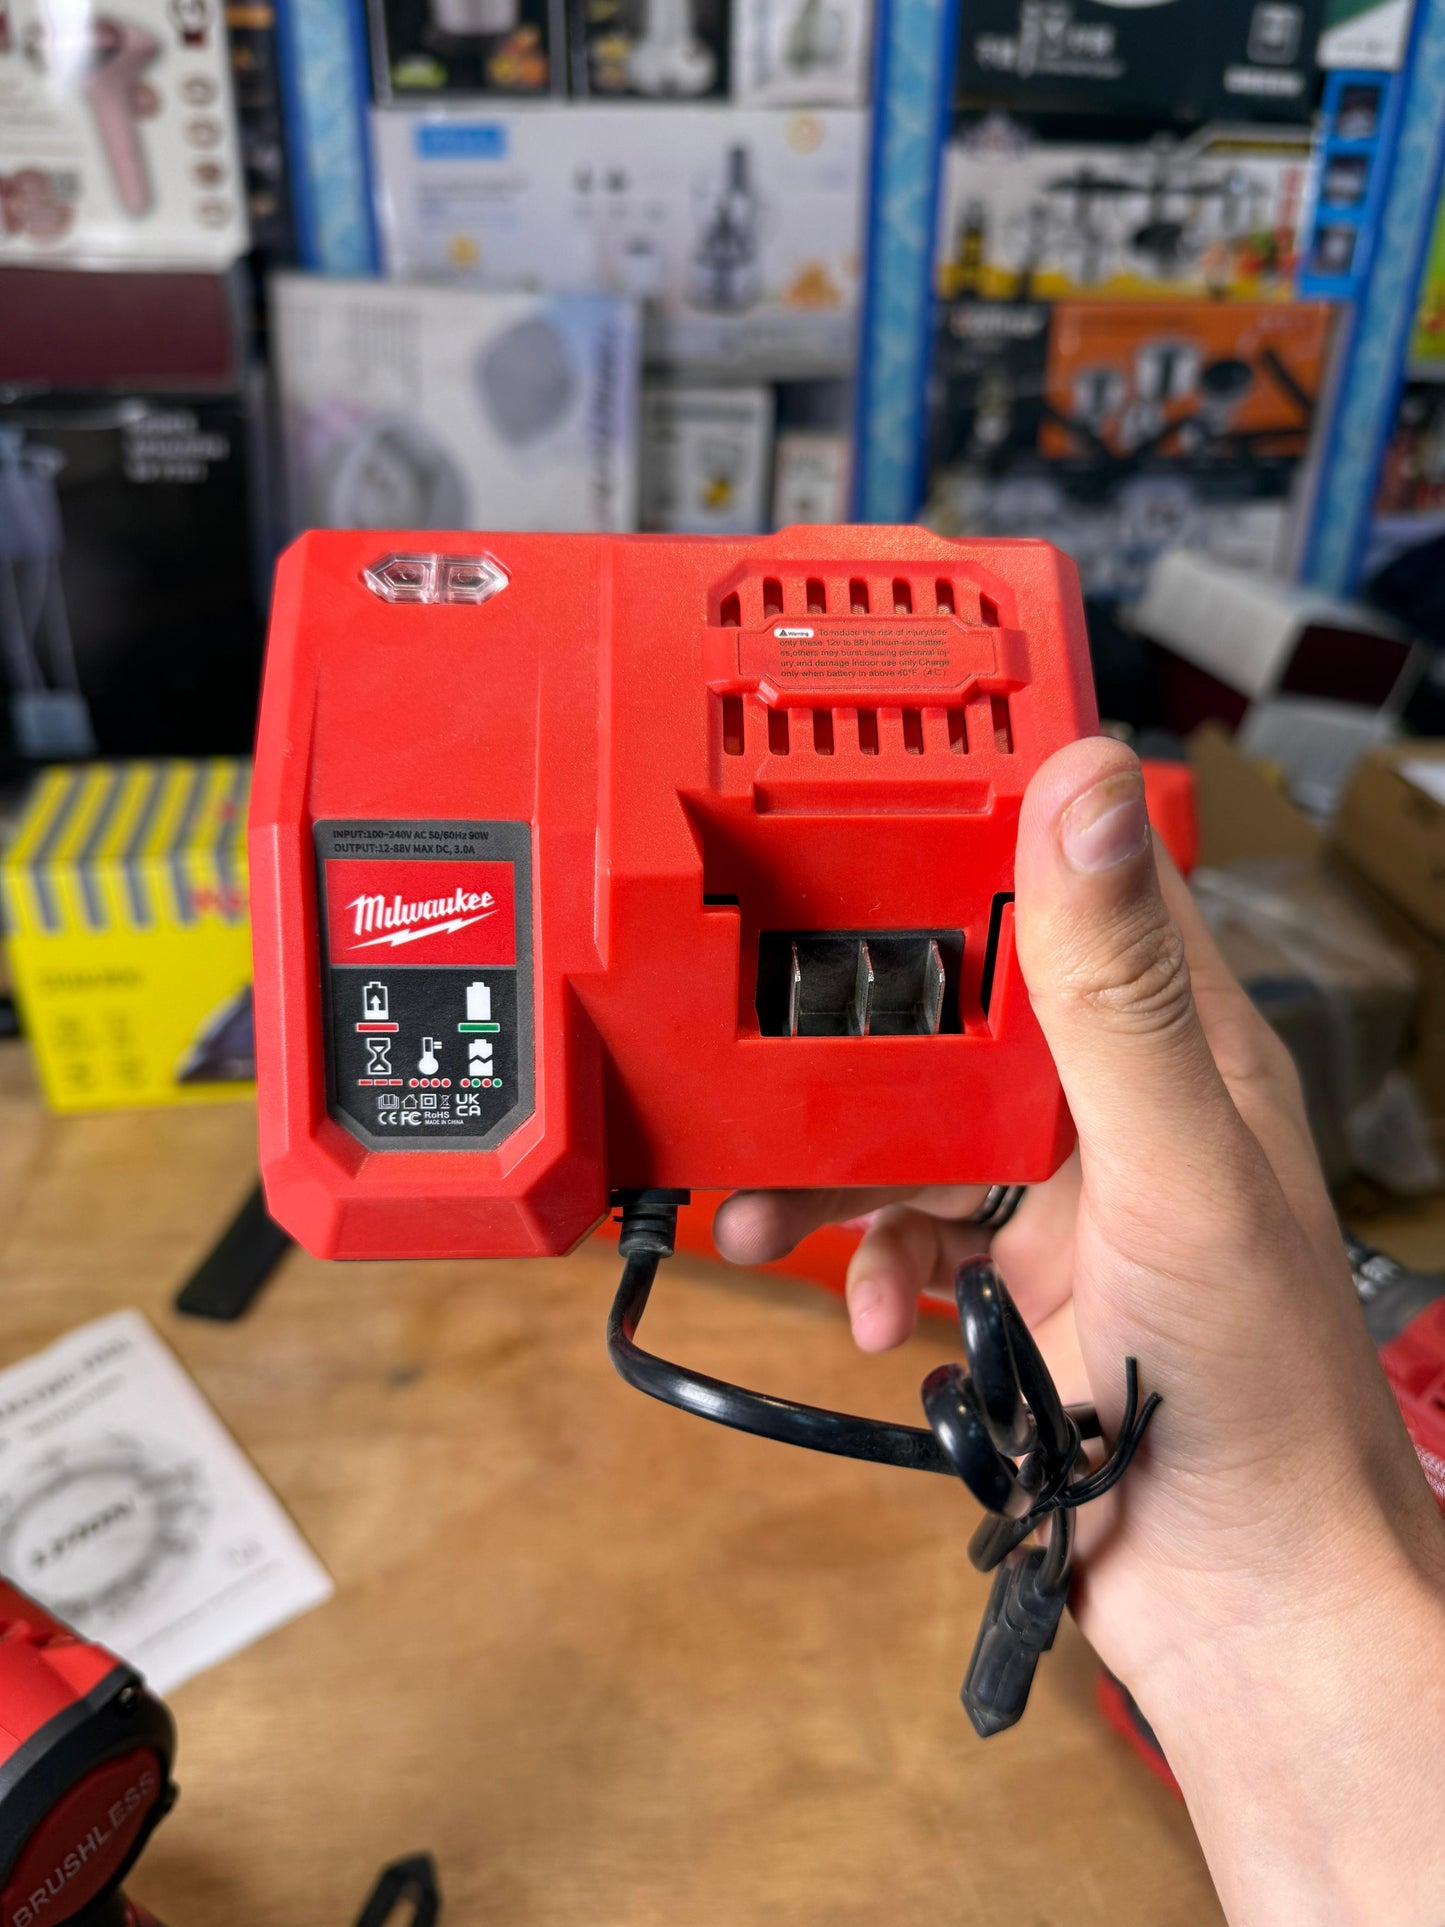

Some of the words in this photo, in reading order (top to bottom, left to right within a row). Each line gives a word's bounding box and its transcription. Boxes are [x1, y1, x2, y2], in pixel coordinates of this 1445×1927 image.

[819, 629, 829, 637] To
[862, 629, 876, 637] the
[878, 629, 893, 637] risk
[895, 629, 904, 637] of
[780, 640, 797, 648] only
[800, 639, 822, 647] these
[841, 649, 862, 657] burst
[864, 650, 897, 658] causing
[899, 650, 935, 658] personal
[815, 660, 849, 669] damage
[899, 660, 917, 668] only
[918, 659, 950, 668] Charge
[781, 670, 798, 678] only
[801, 670, 824, 678] when
[827, 670, 856, 678] battery
[869, 669, 895, 677] above
[413, 831, 427, 841] AC
[429, 831, 468, 842] 50/60Hz
[468, 831, 489, 841] 90W
[413, 844, 434, 854] MAX
[436, 845, 453, 856] DC,
[454, 845, 475, 855] 3.0A
[345, 887, 496, 936] Milwaukee
[455, 1093, 480, 1105] UK
[424, 1111, 450, 1119] RoHS
[456, 1105, 481, 1116] CA
[12, 1771, 154, 1927] BRUSHLESS
